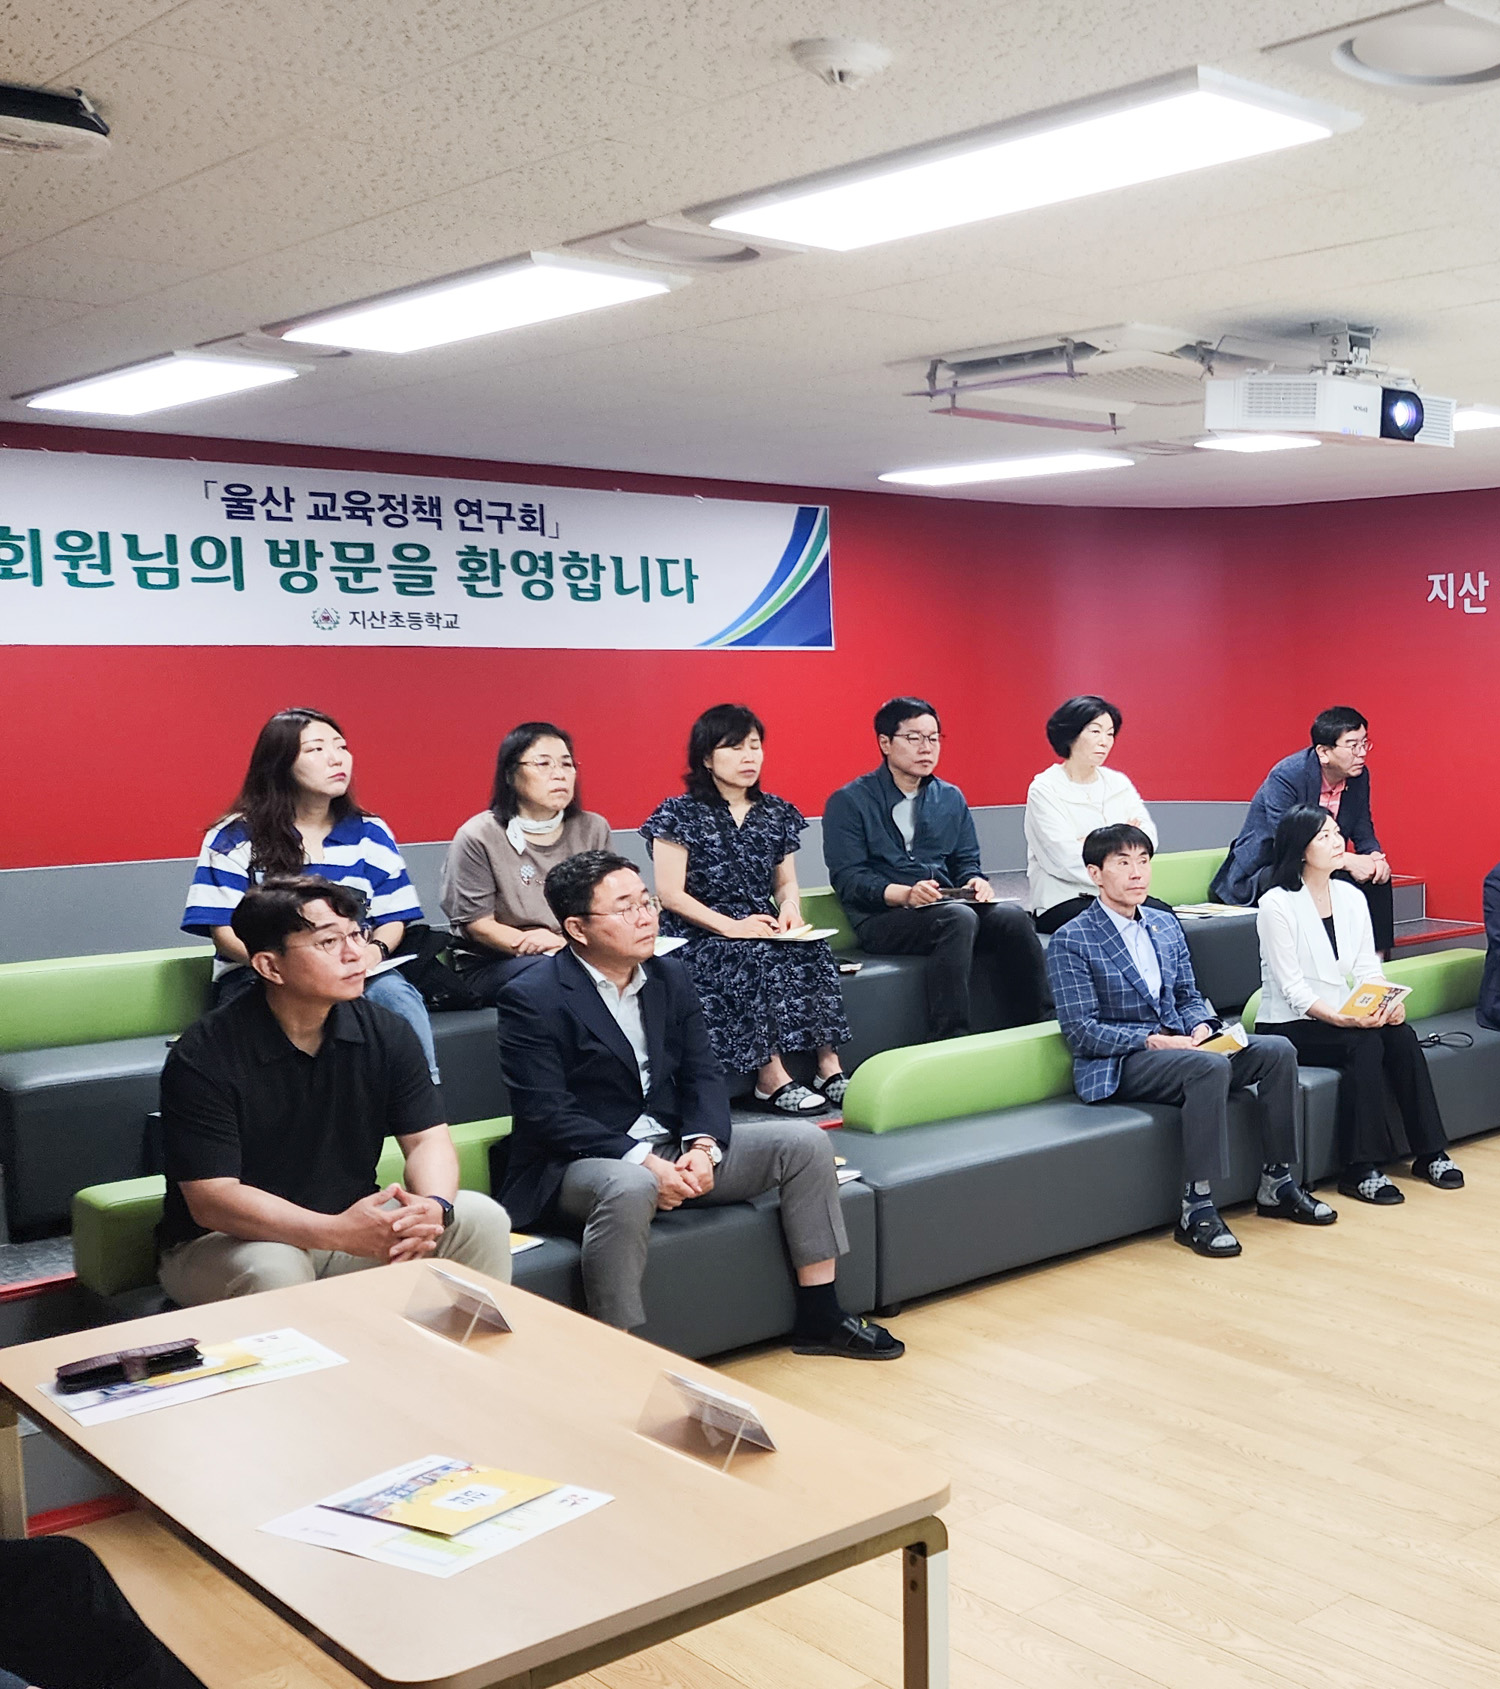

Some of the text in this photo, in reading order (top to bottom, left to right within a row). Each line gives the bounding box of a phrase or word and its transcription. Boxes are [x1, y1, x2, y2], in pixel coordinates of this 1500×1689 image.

[306, 489, 443, 530] 교육정책
[0, 526, 699, 604] 회원님의 방문을 환영합니다
[1427, 571, 1489, 613] 지산
[349, 611, 460, 632] 지산초등학교
